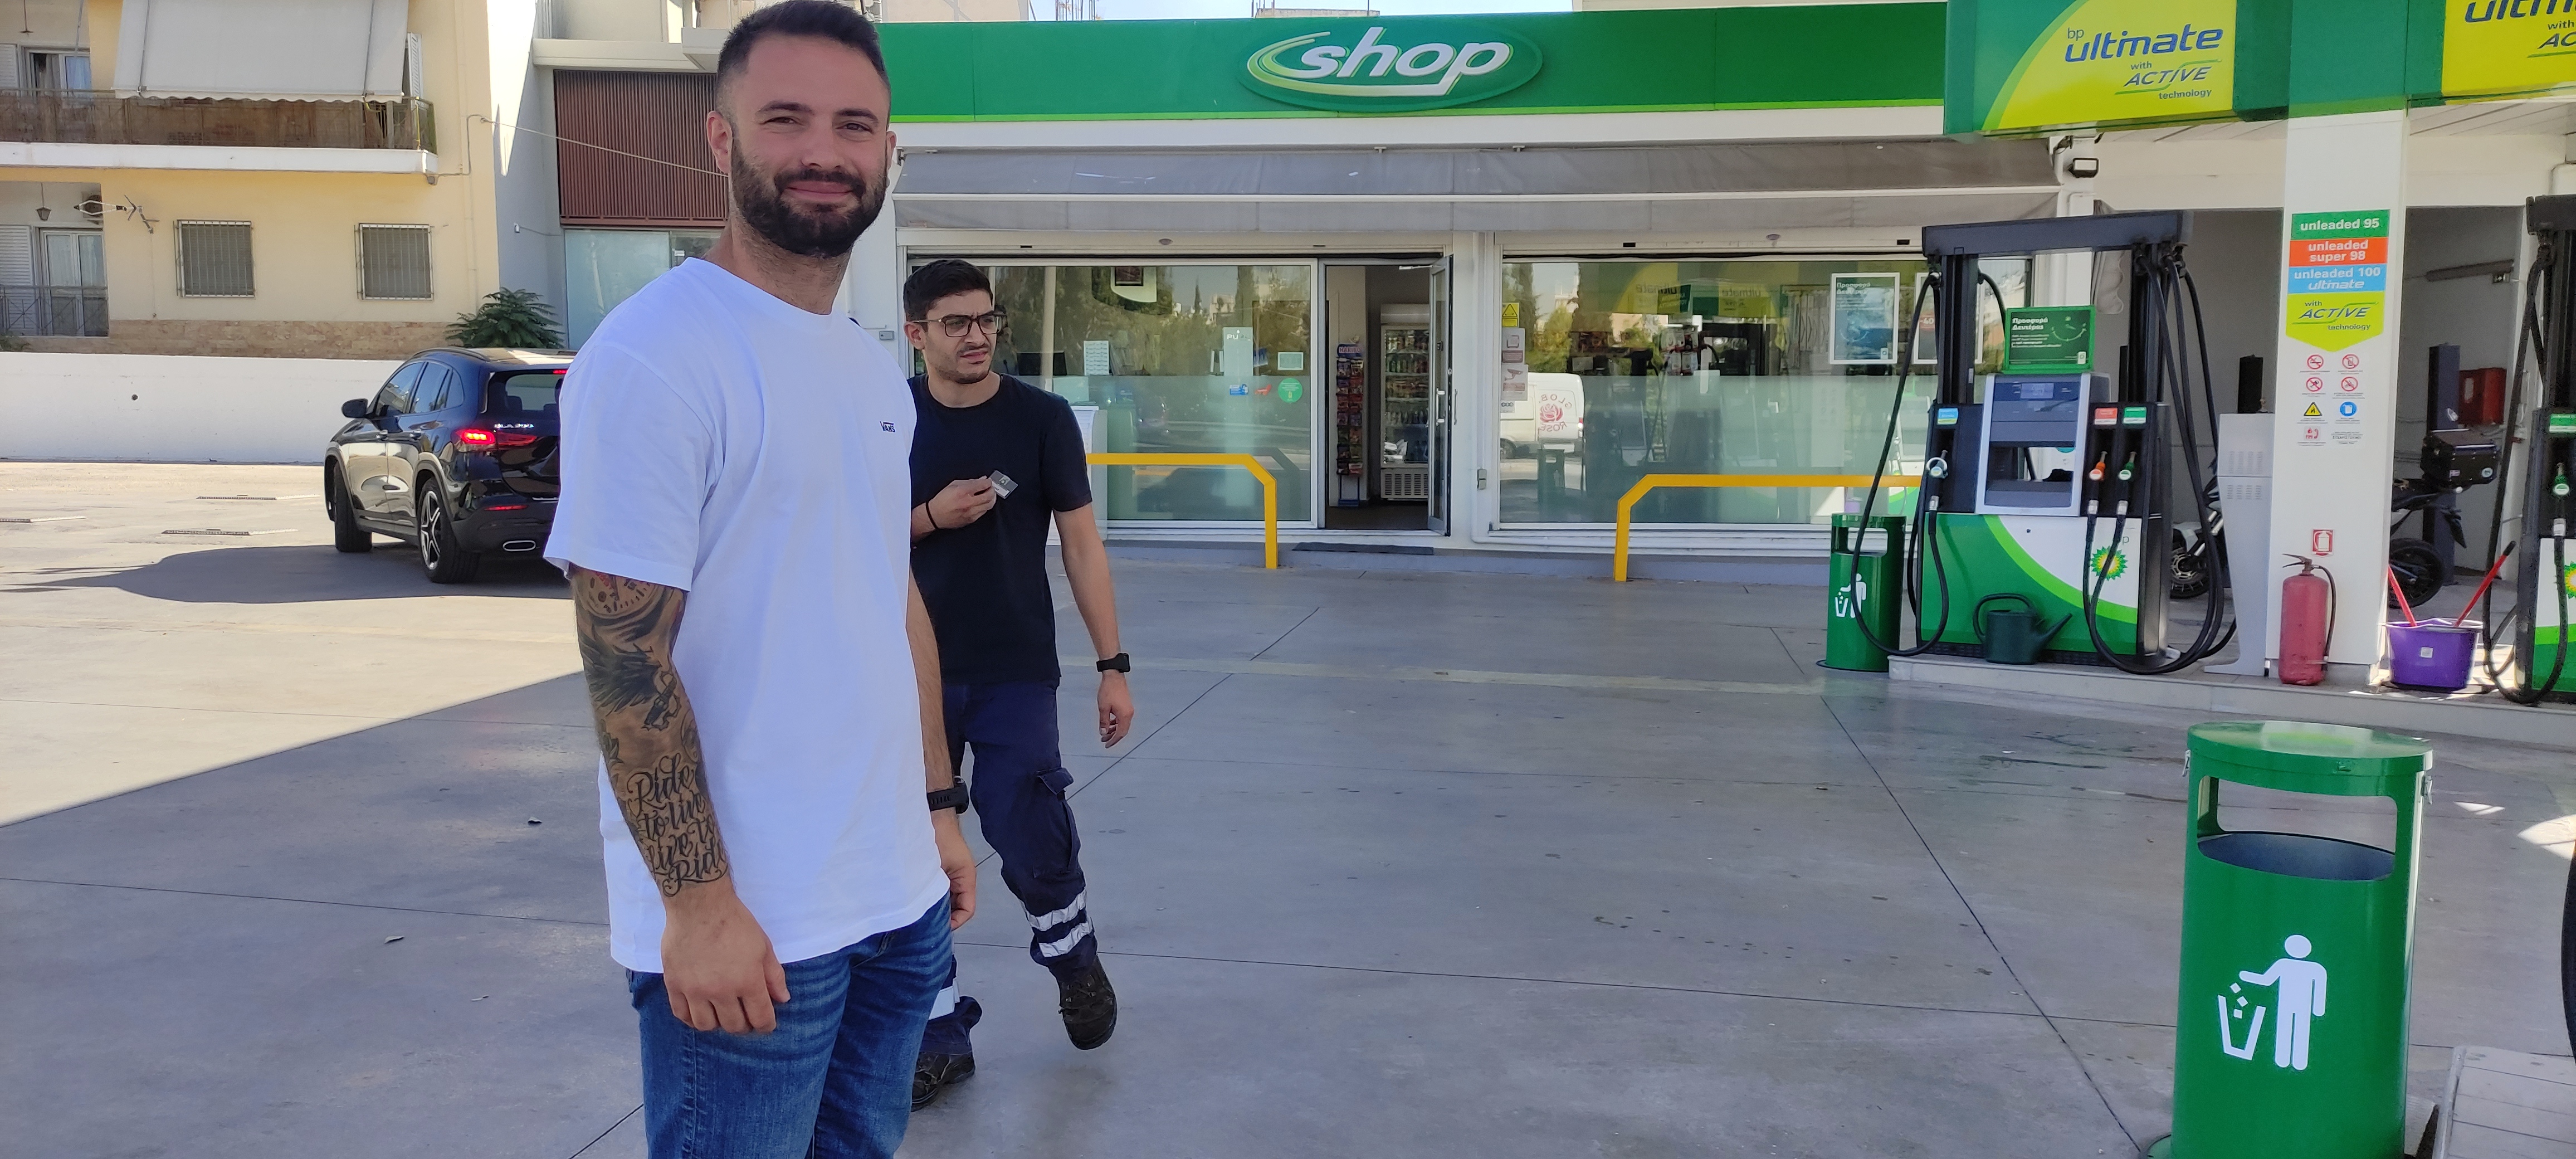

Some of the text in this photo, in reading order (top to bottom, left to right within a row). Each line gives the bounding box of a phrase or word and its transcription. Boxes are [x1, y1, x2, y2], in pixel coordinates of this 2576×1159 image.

[2547, 20, 2575, 31] with
[2067, 27, 2085, 41] bp
[2065, 23, 2223, 62] ultimate
[1301, 26, 1512, 96] shop
[2130, 61, 2152, 70] with
[2123, 66, 2213, 87] ACTIVE
[2158, 89, 2212, 100] technology
[2300, 218, 2380, 231] unleaded 95
[2308, 239, 2369, 251] unleaded
[2309, 250, 2366, 264] super 98
[2294, 267, 2381, 279] unleaded 100
[2308, 279, 2365, 290] ultimate
[2299, 307, 2371, 319] ACTIVE
[880, 421, 896, 433] VANS
[627, 753, 694, 812] Ride
